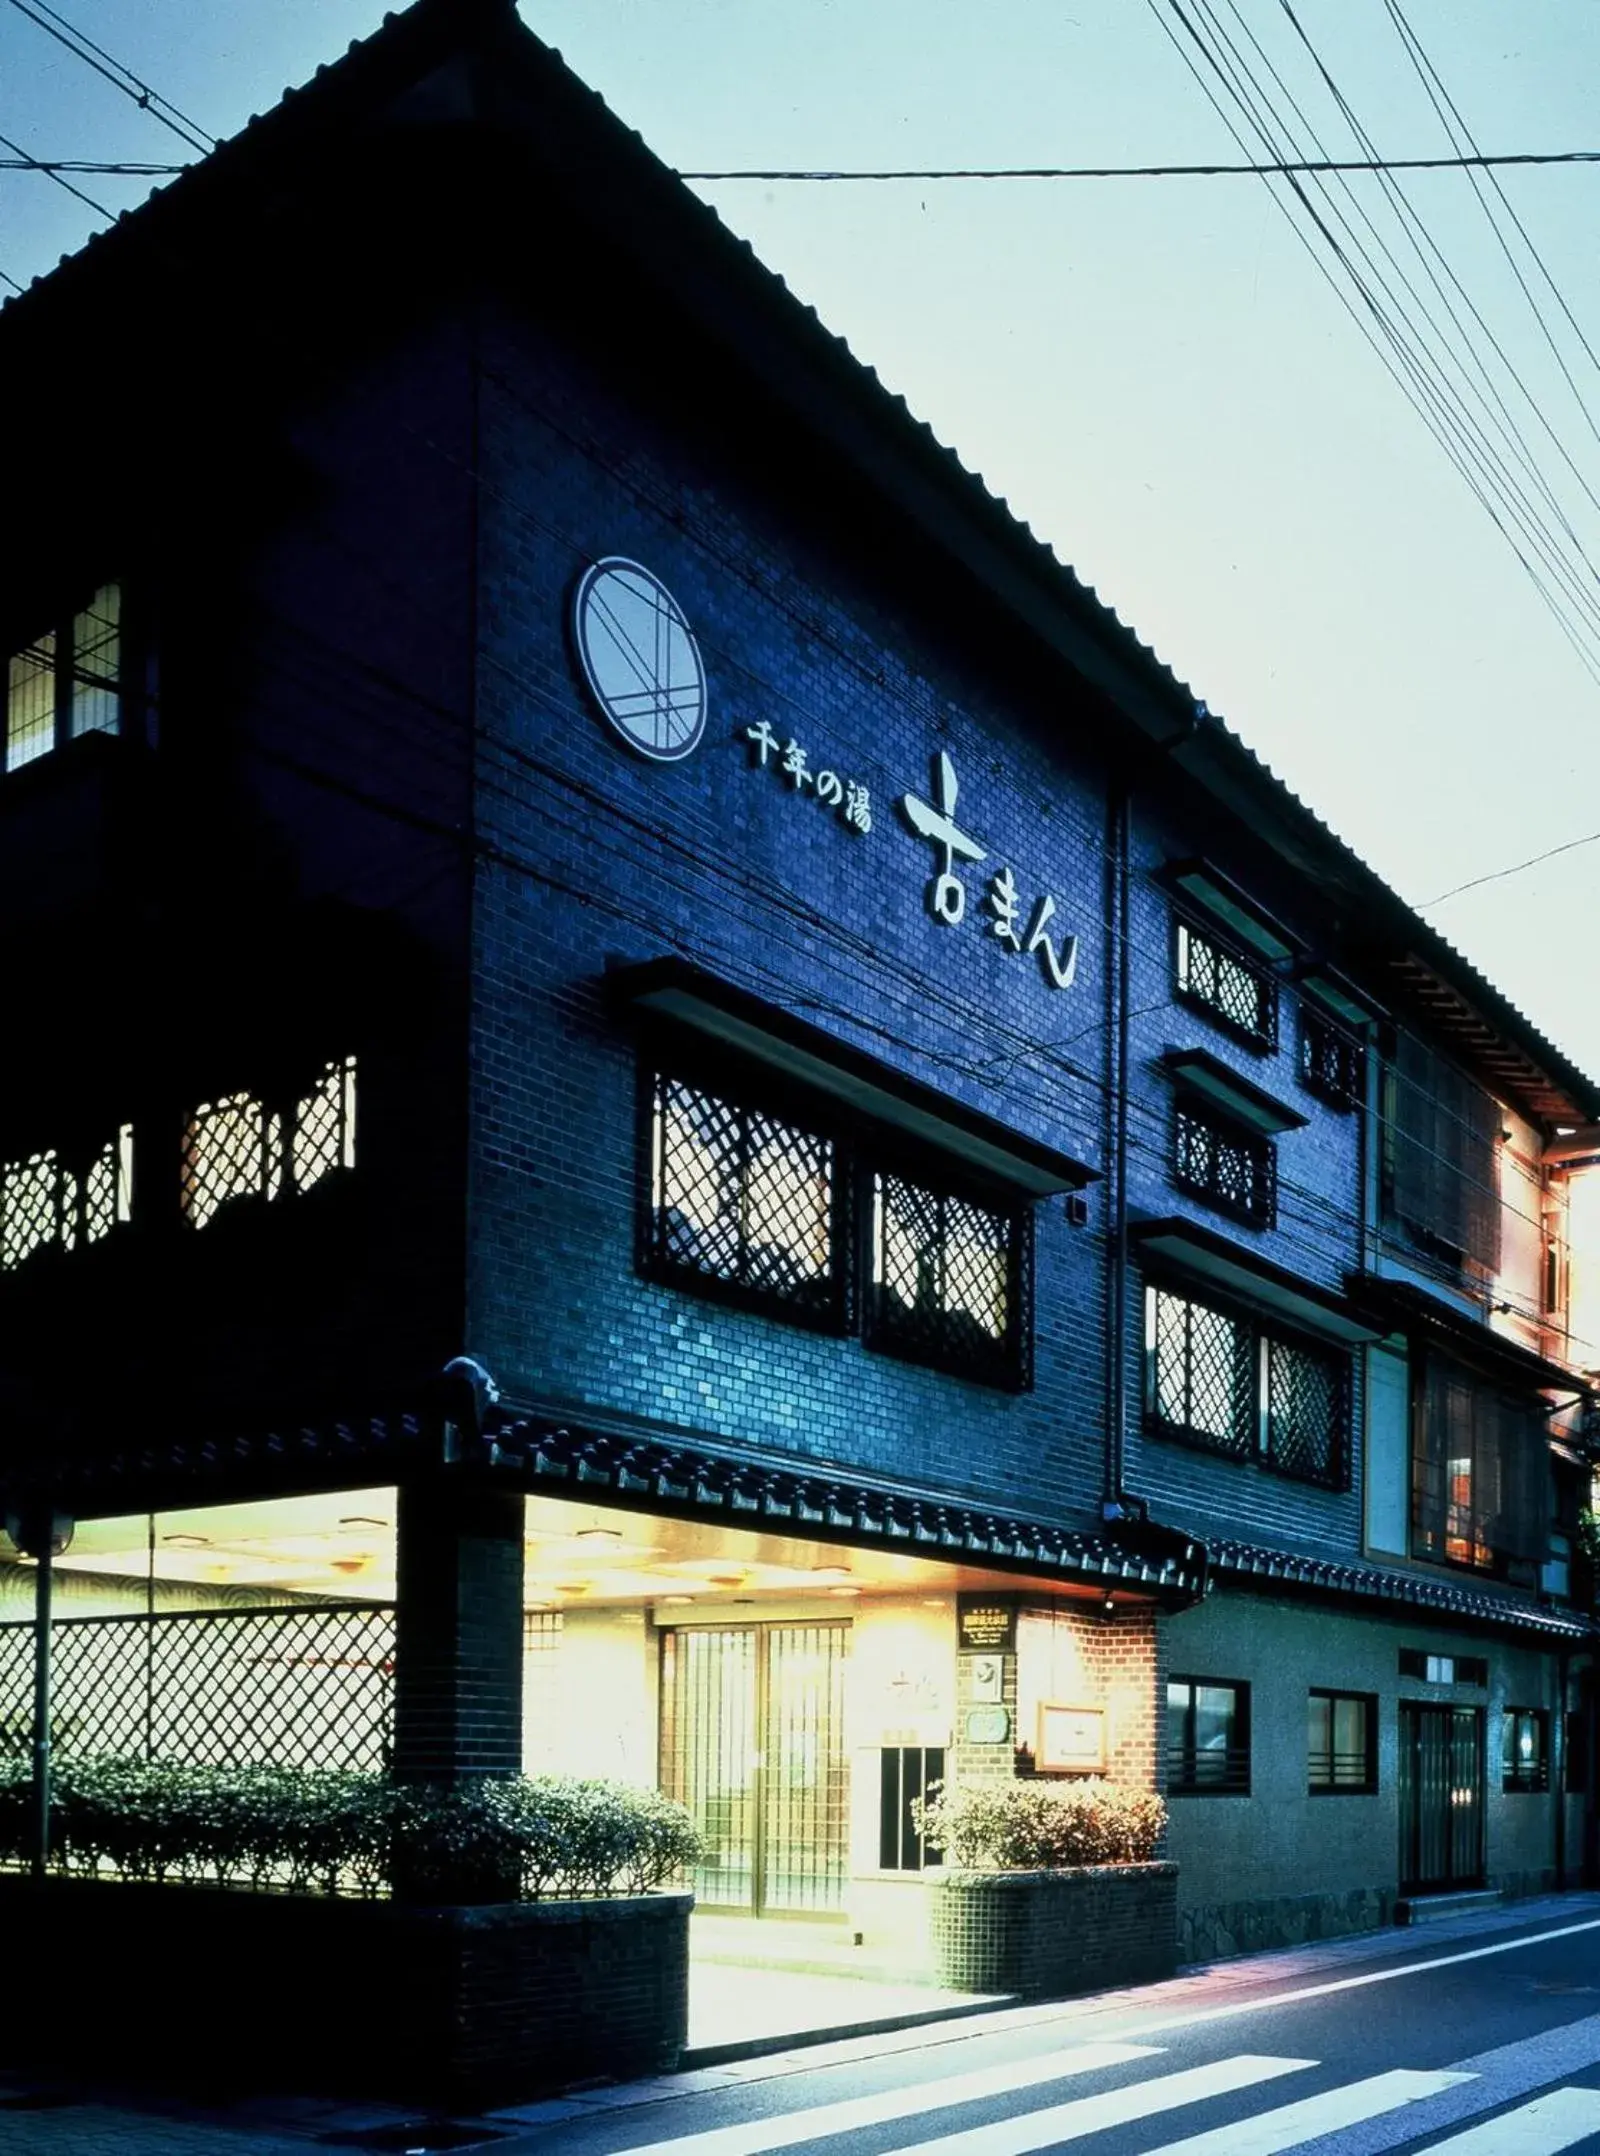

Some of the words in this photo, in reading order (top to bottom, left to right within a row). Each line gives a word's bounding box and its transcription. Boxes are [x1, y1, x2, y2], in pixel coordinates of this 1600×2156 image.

[747, 721, 872, 833] 千年の湯
[904, 751, 1079, 989] 古まん
